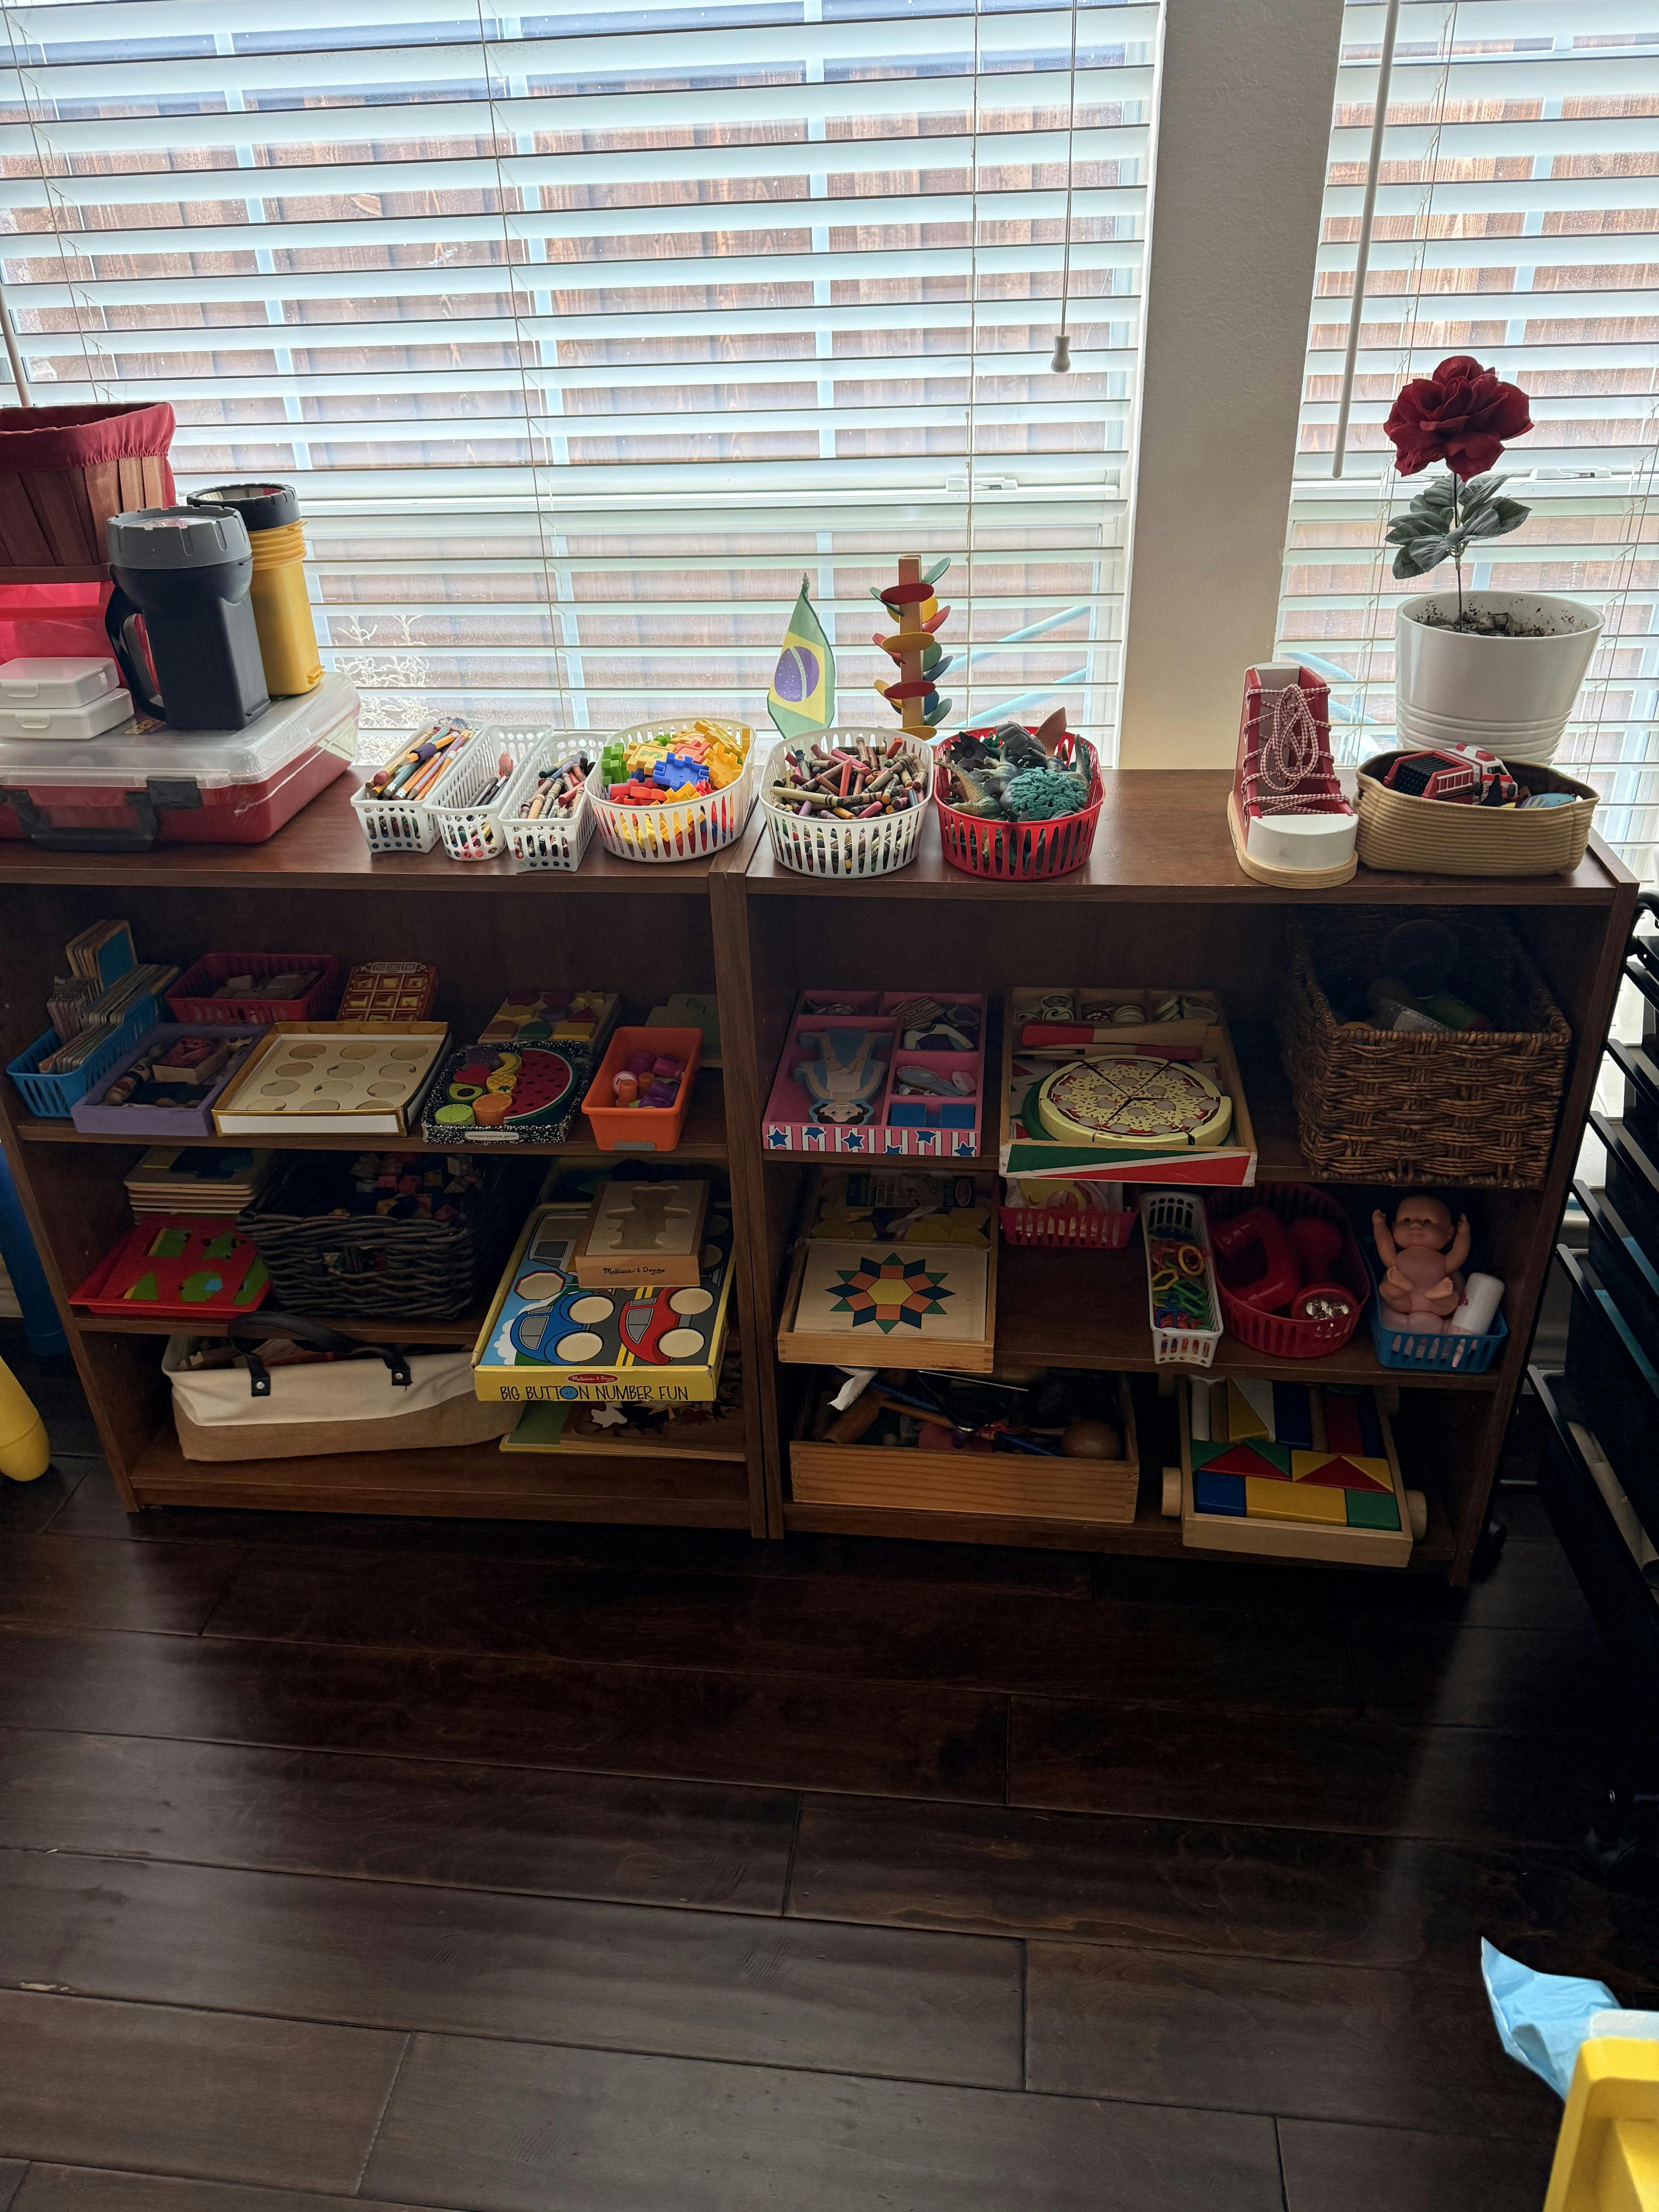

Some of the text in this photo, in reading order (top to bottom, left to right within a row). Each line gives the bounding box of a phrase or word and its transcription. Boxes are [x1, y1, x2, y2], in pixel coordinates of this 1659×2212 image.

[500, 1385, 688, 1400] BIG BUTTON NUMBER FUN
